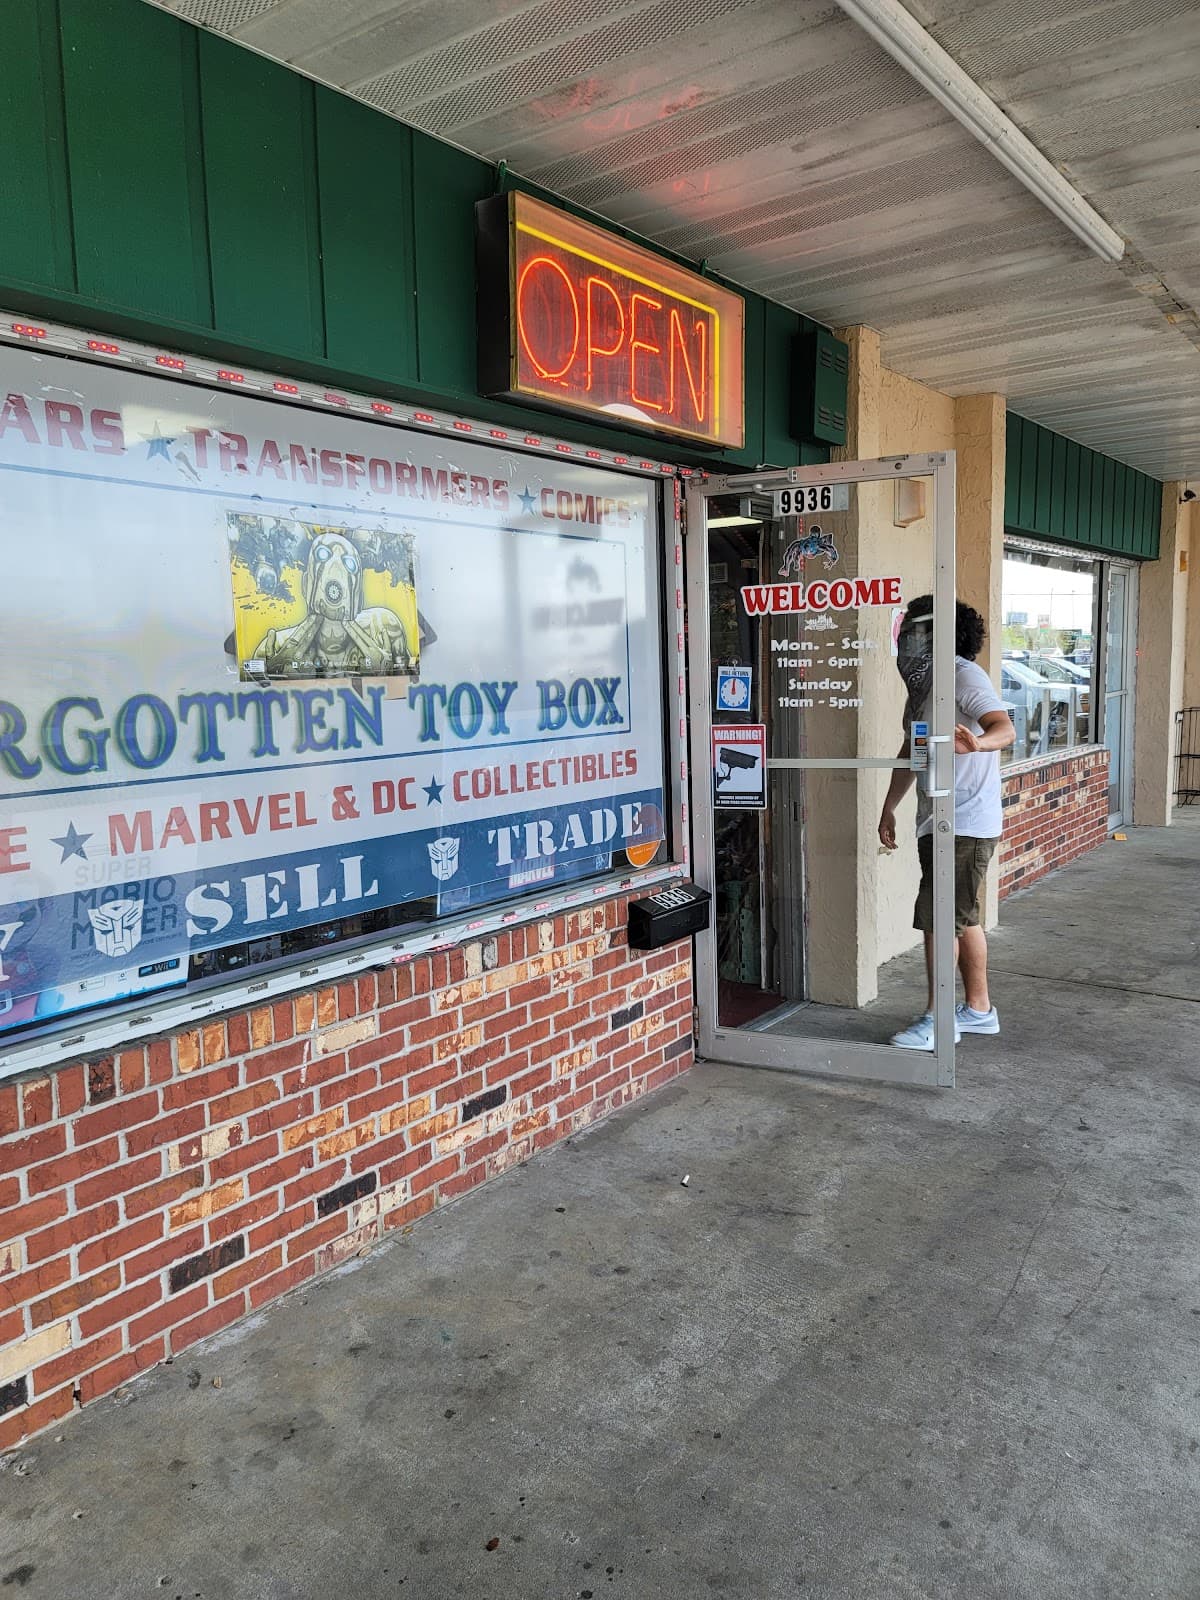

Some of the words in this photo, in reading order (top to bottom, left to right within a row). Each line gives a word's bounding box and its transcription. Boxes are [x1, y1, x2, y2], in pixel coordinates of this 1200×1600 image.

[516, 256, 706, 422] OPEN
[0, 392, 126, 456] ARS
[186, 425, 510, 511] TRANSFORMERS
[780, 486, 832, 514] 9936
[741, 577, 902, 613] WELCOME
[770, 639, 820, 652] Mon.
[776, 657, 813, 668] 11am
[827, 656, 864, 669] 6pm
[788, 677, 853, 692] Sunday
[777, 696, 814, 708] 11am
[828, 696, 864, 710] 5pm
[0, 685, 387, 781] RGOTTEN
[407, 680, 518, 743] TOY
[535, 675, 625, 733] BOX
[714, 729, 762, 741] WARNING!
[107, 790, 318, 857] MARVEL
[331, 785, 361, 822] &
[372, 776, 417, 815] DC
[452, 749, 639, 802] COLLECTIBLES
[74, 856, 152, 887] SUPER
[184, 855, 379, 938] SELL
[487, 801, 643, 867] TRADE
[651, 889, 692, 908] 9936
[71, 903, 178, 950] MER
